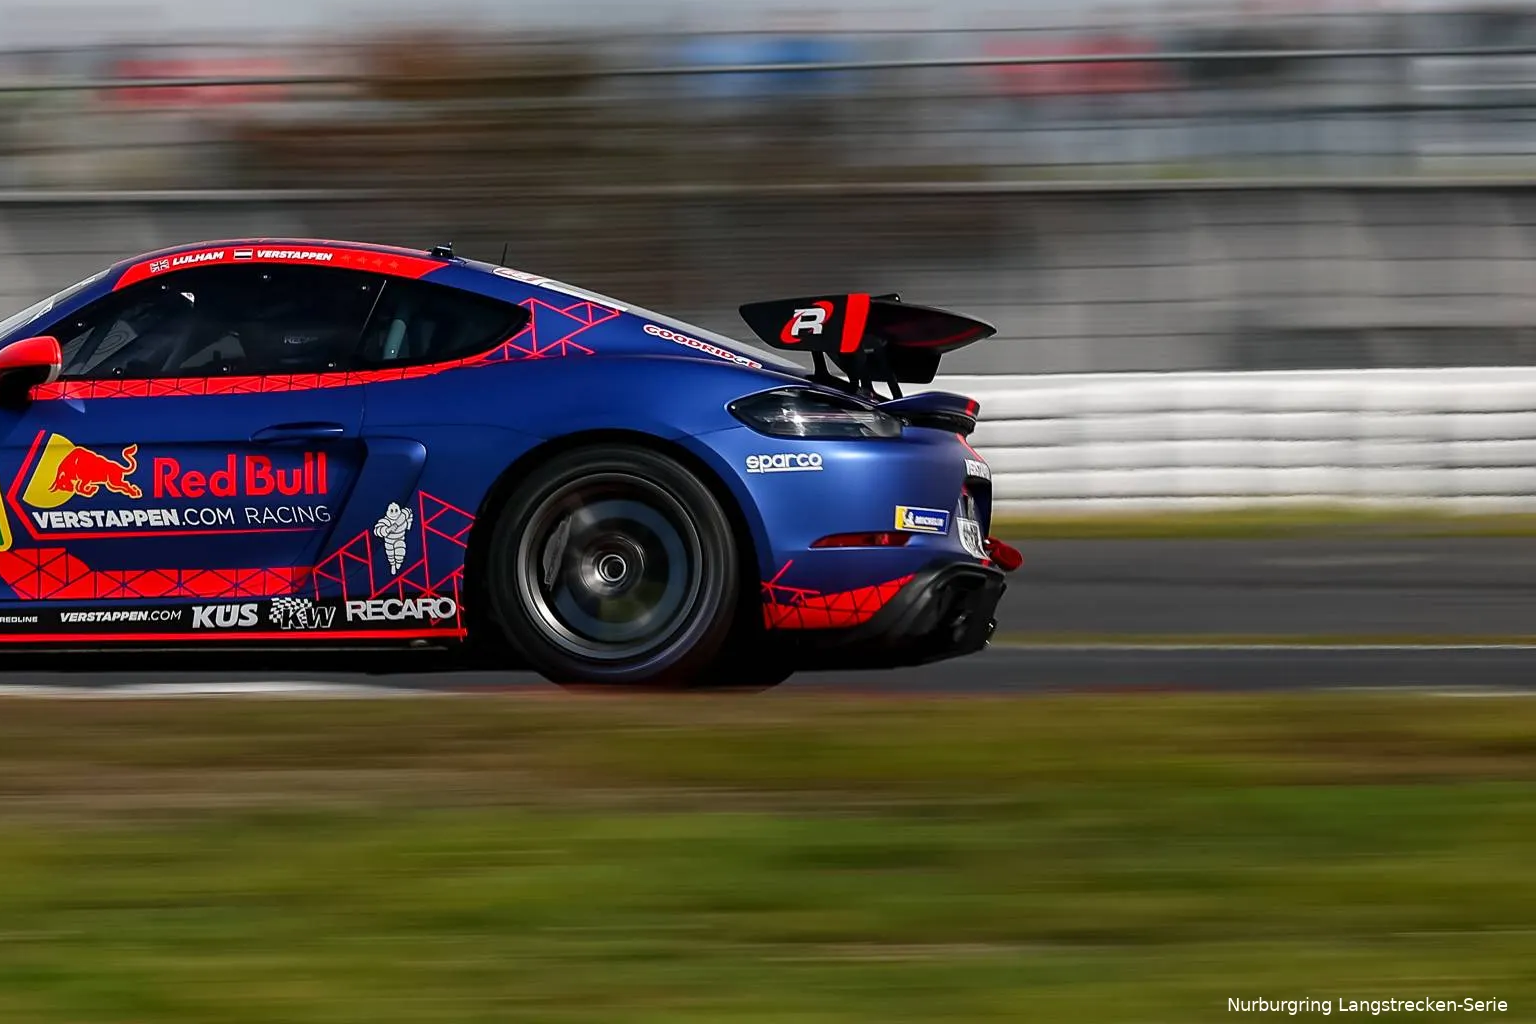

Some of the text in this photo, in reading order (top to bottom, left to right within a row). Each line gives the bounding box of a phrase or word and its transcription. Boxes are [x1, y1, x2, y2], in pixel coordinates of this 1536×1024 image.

[172, 251, 225, 266] LULHAM
[256, 250, 333, 261] VERSTAPPEN
[746, 453, 823, 473] sparco
[153, 452, 328, 499] Red Bull
[32, 505, 331, 529] VERSTAPPEN.COM RACING
[60, 609, 182, 623] VERSTAPPEN.COM
[191, 603, 259, 629] KÜS
[345, 597, 457, 622] RECARO
